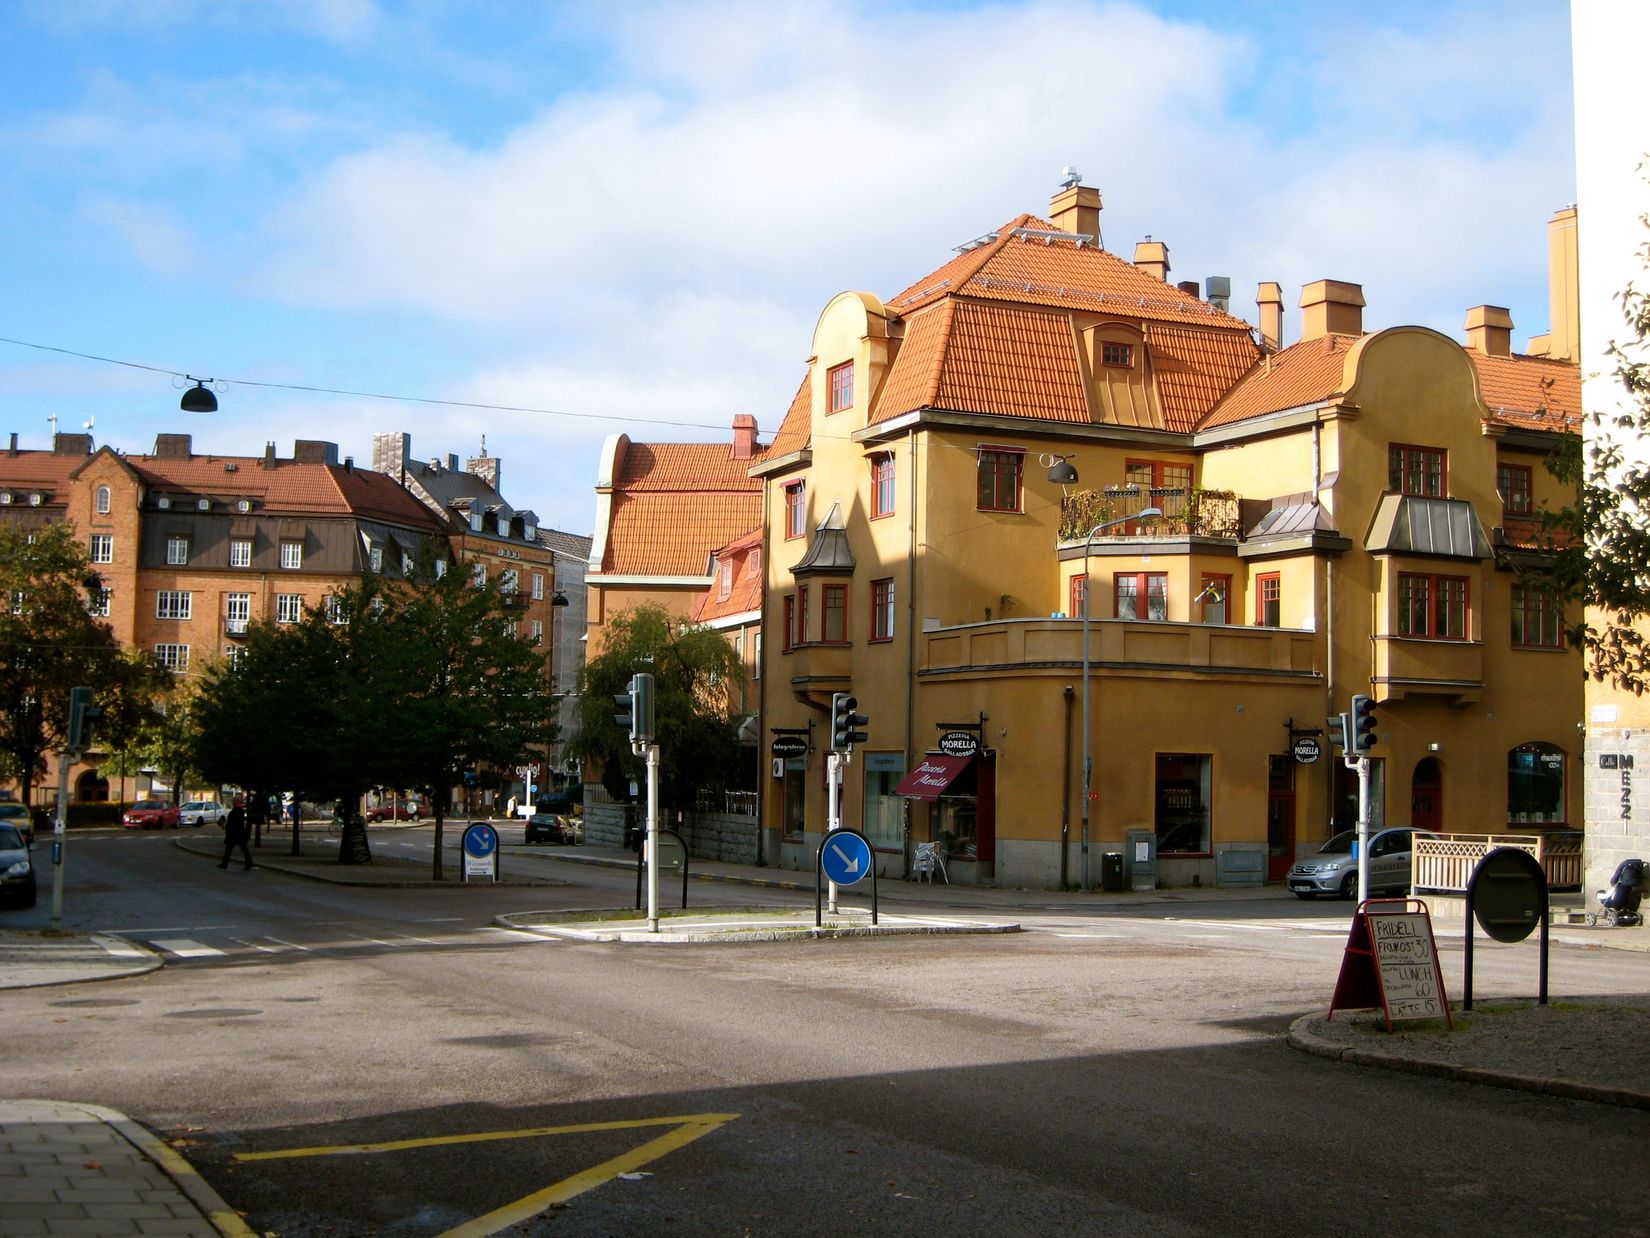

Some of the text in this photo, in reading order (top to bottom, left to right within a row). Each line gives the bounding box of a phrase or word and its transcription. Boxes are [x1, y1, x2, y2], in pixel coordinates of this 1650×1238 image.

[941, 740, 977, 749] MORELLA
[1294, 746, 1319, 755] MORELLA
[1619, 754, 1634, 819] MEZZ
[1399, 966, 1432, 981] LUNCH
[1416, 981, 1430, 997] 60
[1390, 999, 1435, 1017] LATTE 15
